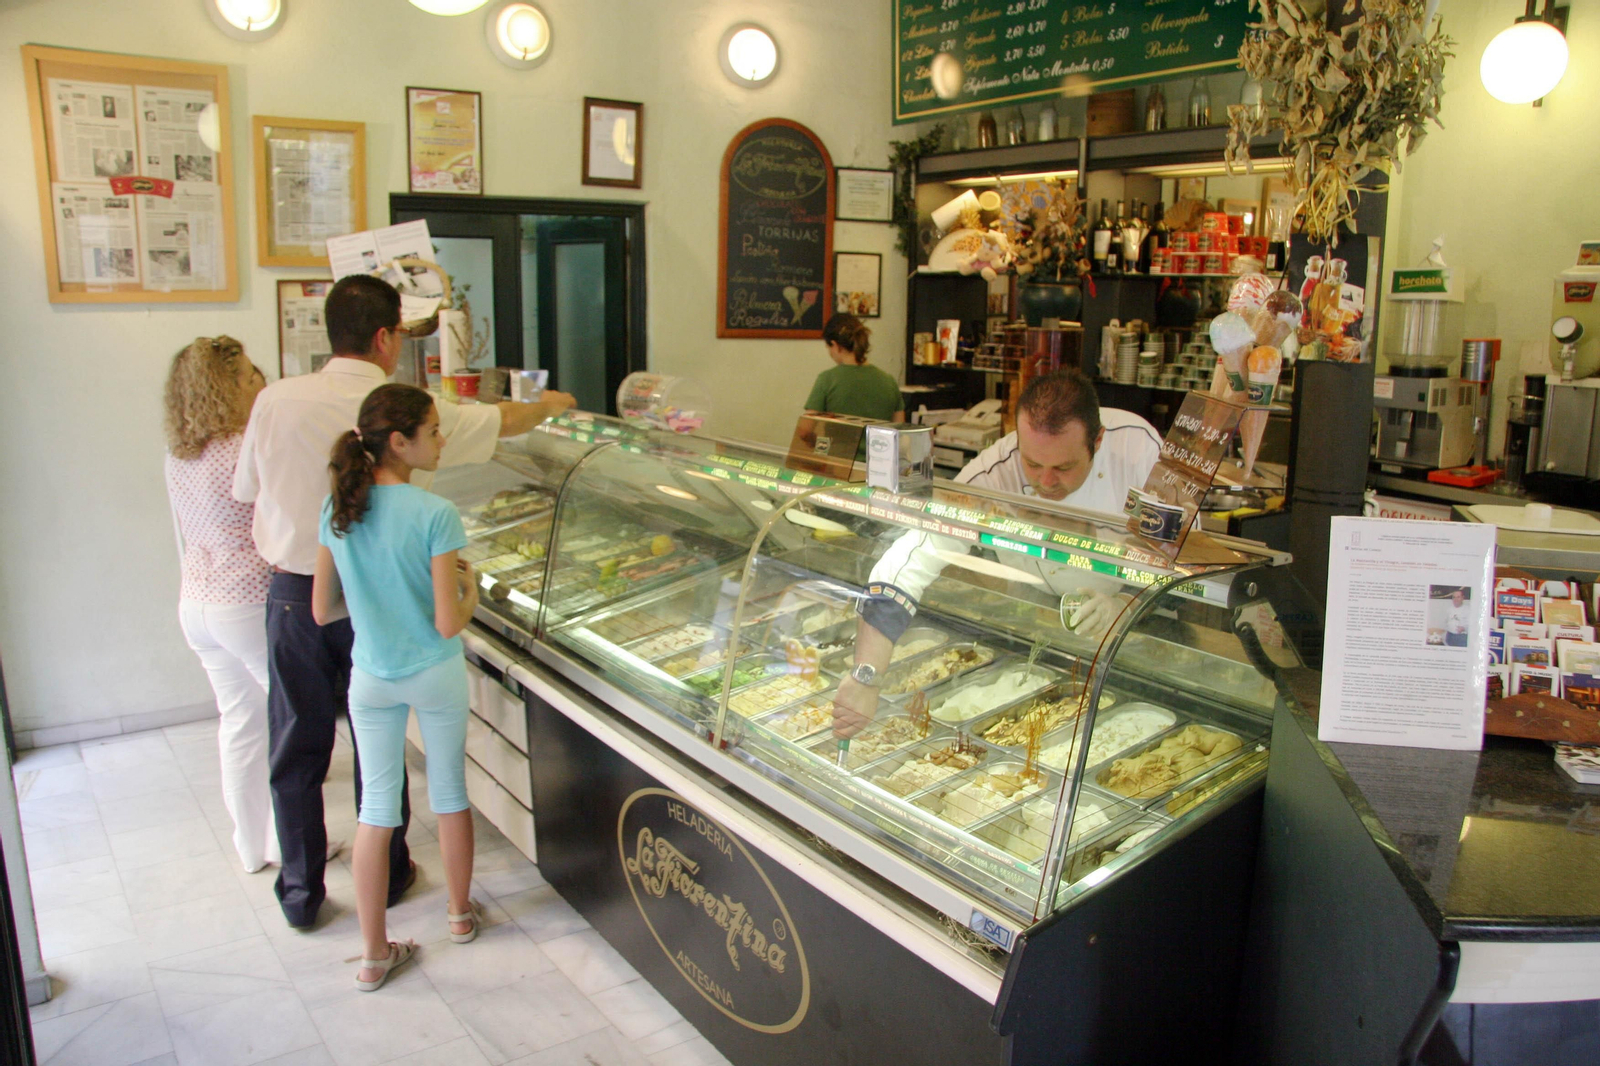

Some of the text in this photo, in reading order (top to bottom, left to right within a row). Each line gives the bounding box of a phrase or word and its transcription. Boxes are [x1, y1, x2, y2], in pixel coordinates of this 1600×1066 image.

[1107, 26, 1130, 42] 5,50
[757, 225, 820, 243] TORRIJAS
[1399, 275, 1442, 287] horchata
[1182, 481, 1199, 497] 3,70
[1053, 533, 1121, 555] DULCE DE LECHE
[1125, 550, 1151, 564] DULCE
[1502, 595, 1534, 606] 7 Days
[667, 801, 733, 862] HELADERIA
[627, 827, 654, 895] La
[984, 918, 1001, 940] ISA
[676, 950, 735, 1009] ARTESANA
